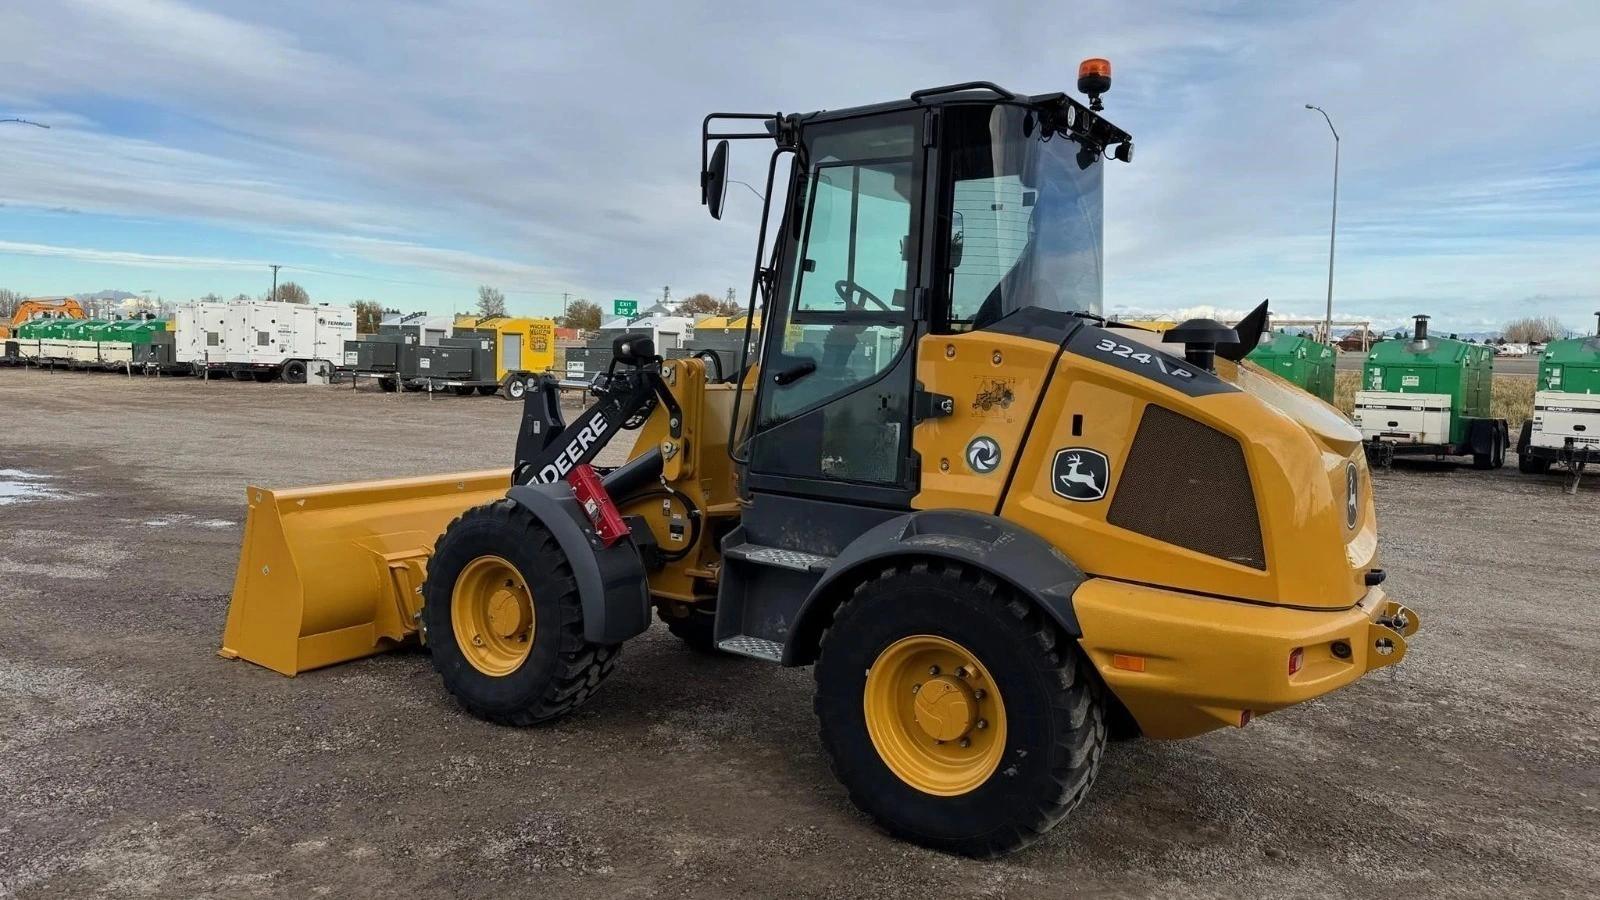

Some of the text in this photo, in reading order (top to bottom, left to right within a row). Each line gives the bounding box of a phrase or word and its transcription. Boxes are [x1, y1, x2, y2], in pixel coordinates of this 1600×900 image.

[1095, 338, 1193, 378] 324 P
[539, 412, 608, 484] DEERE
